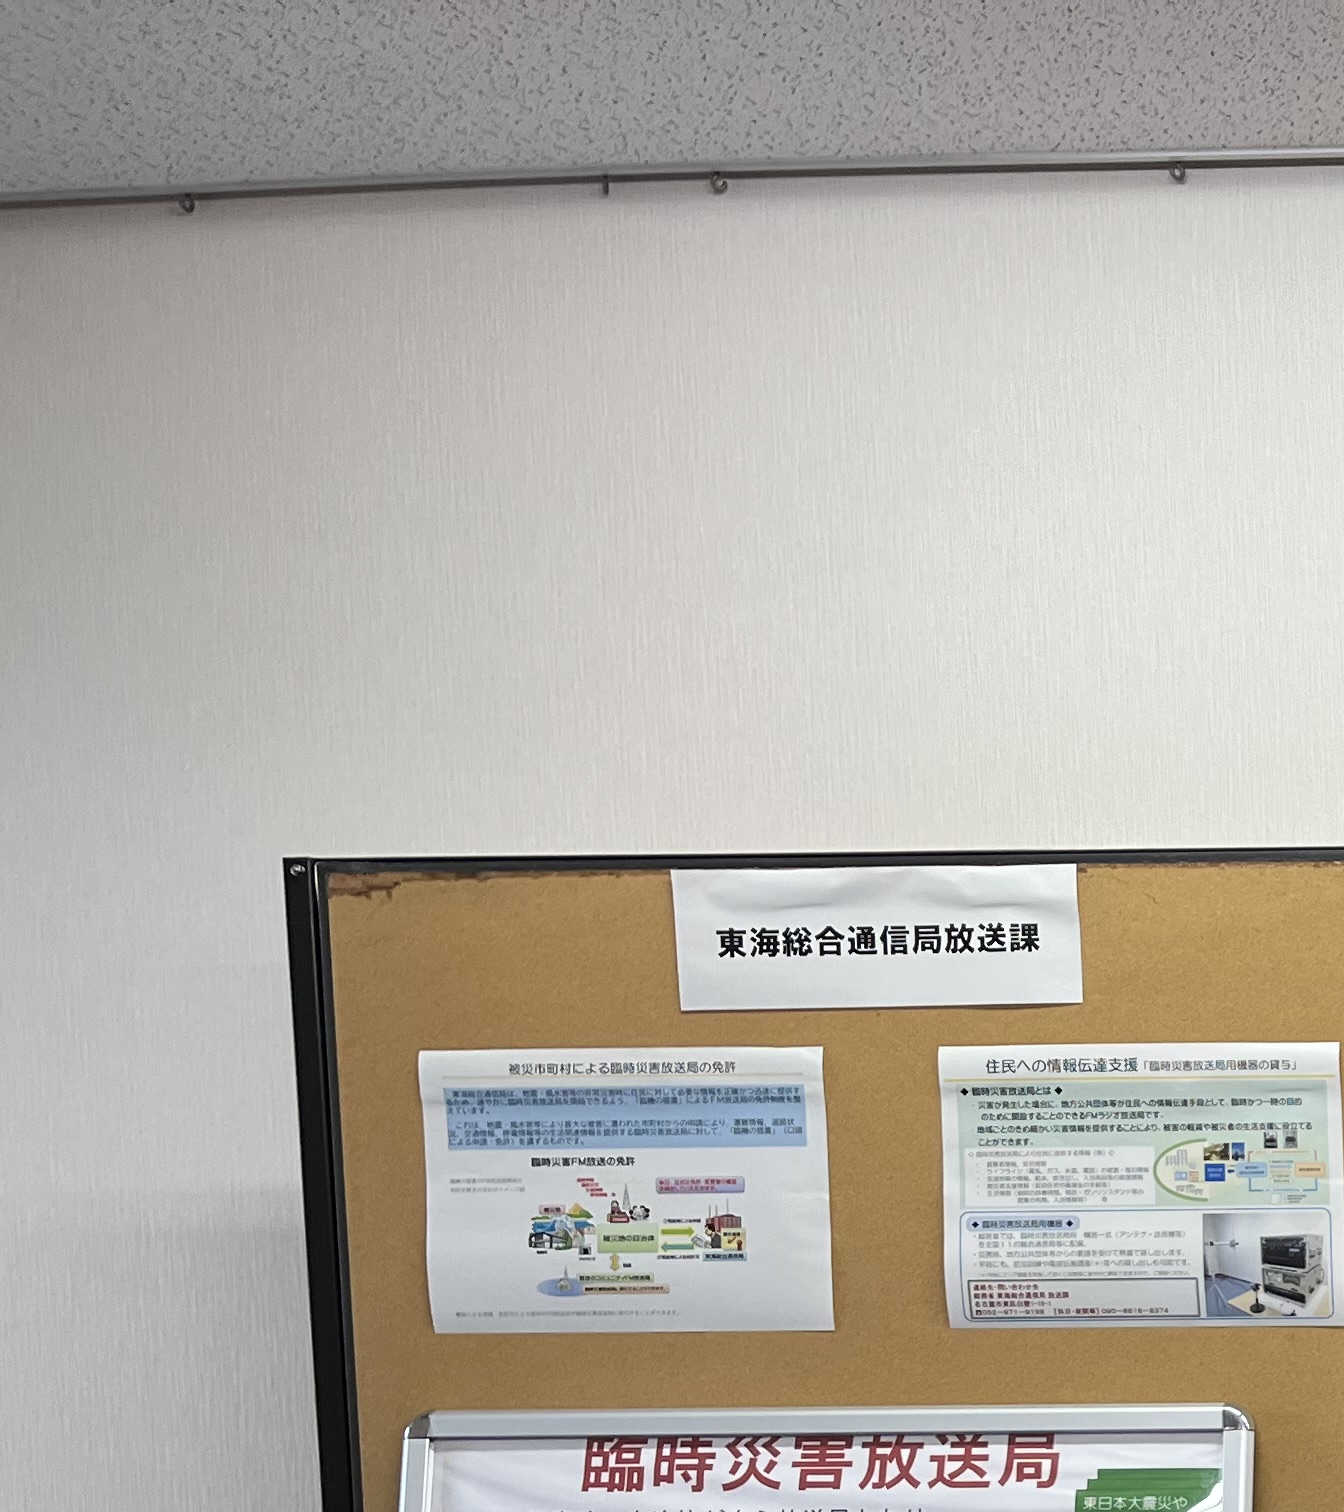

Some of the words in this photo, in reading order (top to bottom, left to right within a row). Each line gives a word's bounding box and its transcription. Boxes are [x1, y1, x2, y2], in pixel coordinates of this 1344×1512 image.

[715, 922, 1041, 958] 東海総合通信局放送課
[508, 1061, 737, 1076] 被災市町村による臨時災害放送局の免許
[580, 1433, 1062, 1493] 臨時災害放送局
[1082, 1496, 1188, 1510] 東日本大震災や
